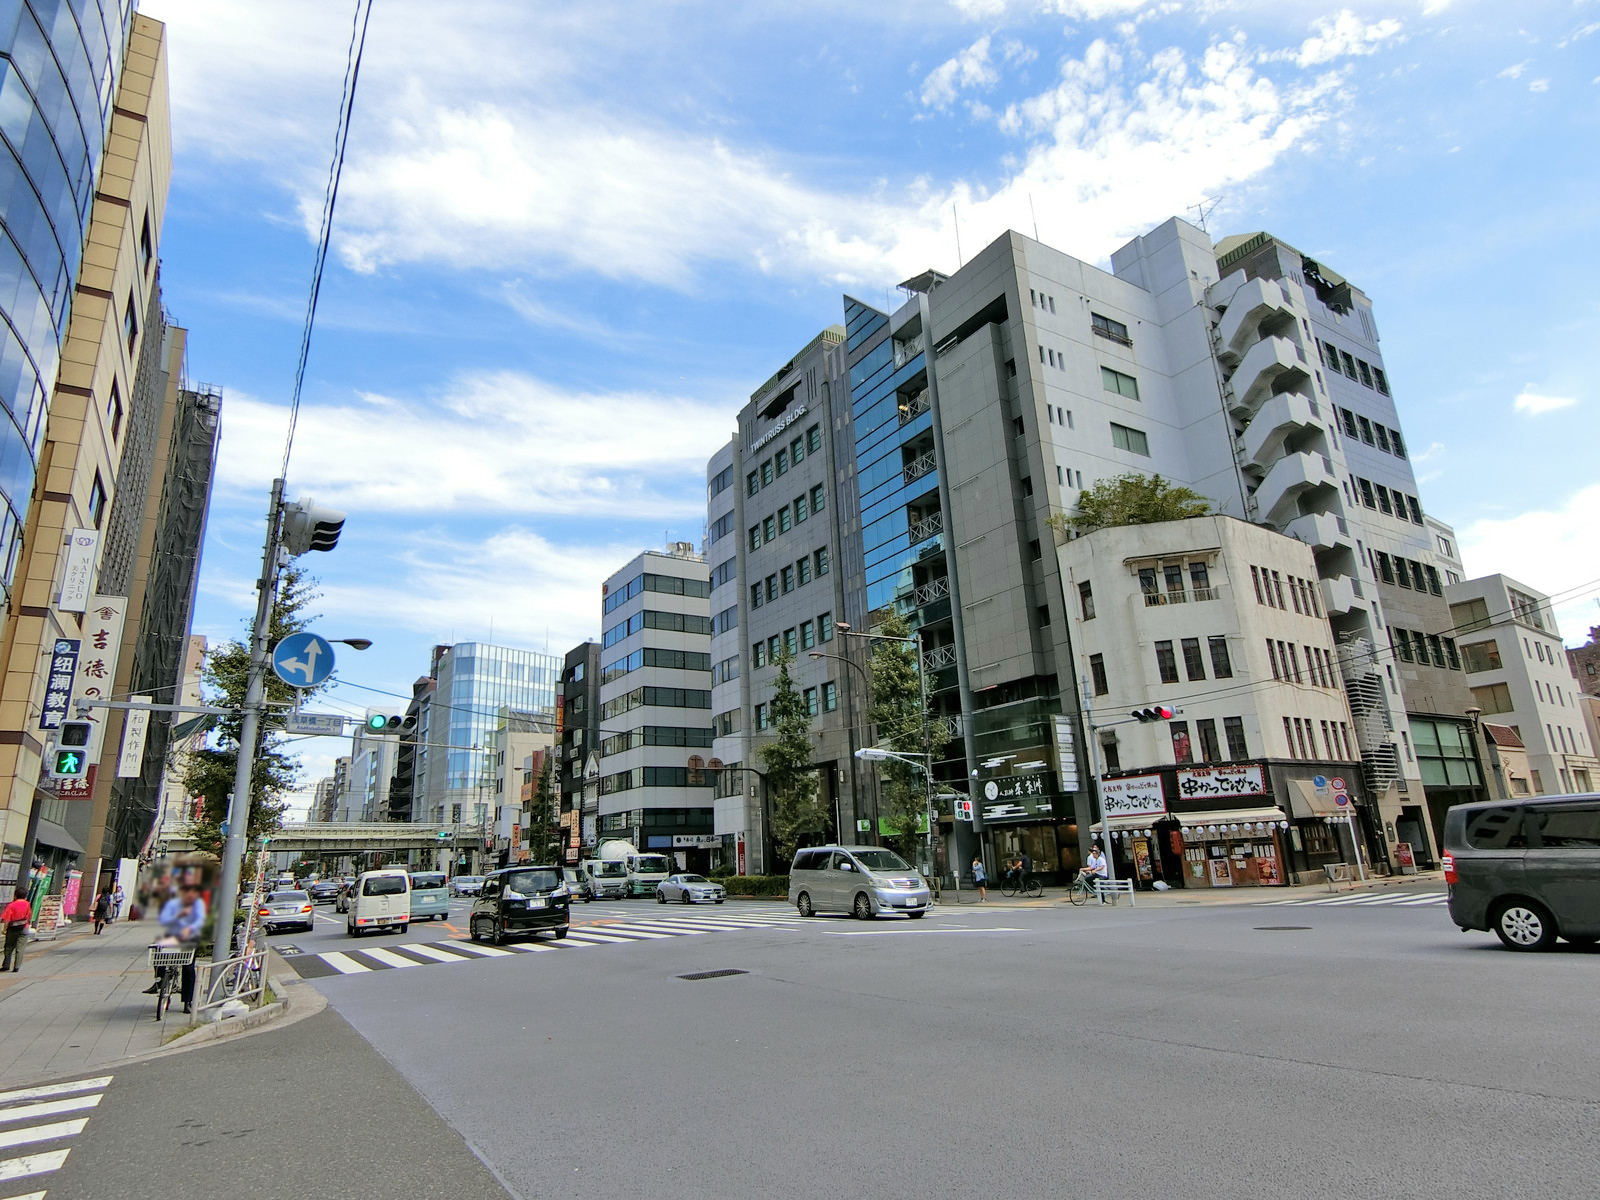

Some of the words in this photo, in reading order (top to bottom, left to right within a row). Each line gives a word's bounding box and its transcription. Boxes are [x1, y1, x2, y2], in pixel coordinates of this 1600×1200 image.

[750, 420, 785, 453] TWINTRUSS
[75, 557, 89, 599] MATSUO
[44, 656, 74, 727] 纽澜教育
[125, 708, 144, 763] 和製作所
[1104, 794, 1162, 812] 串かつでんがな
[1181, 777, 1260, 796] 串かつでんがな
